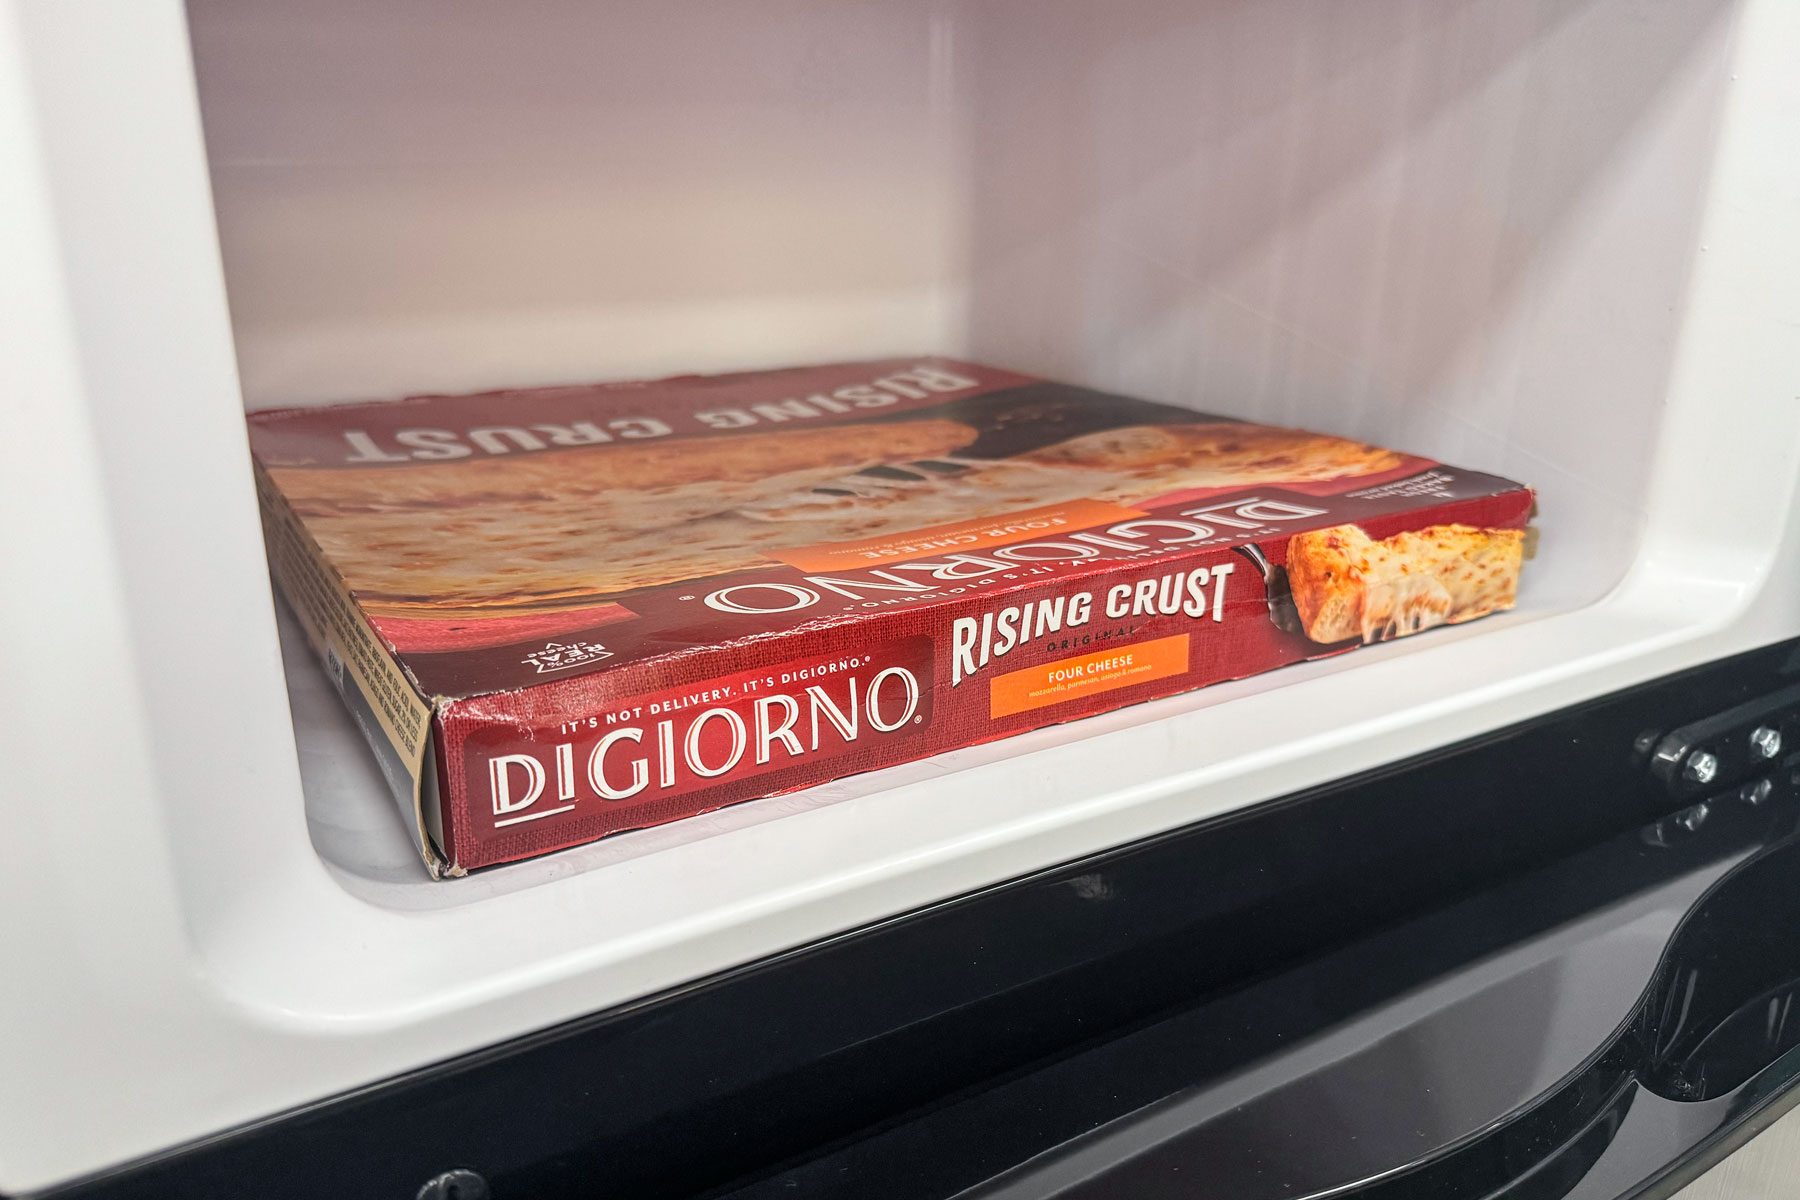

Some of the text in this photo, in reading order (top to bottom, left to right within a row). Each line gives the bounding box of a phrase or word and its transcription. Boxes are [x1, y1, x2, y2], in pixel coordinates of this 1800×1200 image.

[344, 366, 980, 463] RISING CRUST
[981, 517, 1068, 538] FOUR
[703, 497, 1330, 615] DIGIORNO
[859, 534, 979, 560] CHEESE
[952, 562, 1235, 688] RISING CRUST
[1046, 625, 1134, 653] ORIGINAL
[521, 643, 606, 666] REAL
[527, 641, 588, 658] cheese
[547, 652, 596, 668] 100%
[1047, 653, 1134, 684] FOUR CHEESE
[561, 717, 598, 735] IT'S
[606, 707, 643, 725] NOT
[650, 686, 737, 716] DELIVERY.
[743, 676, 775, 694] IT'S
[488, 665, 919, 817] DIGIORNO
